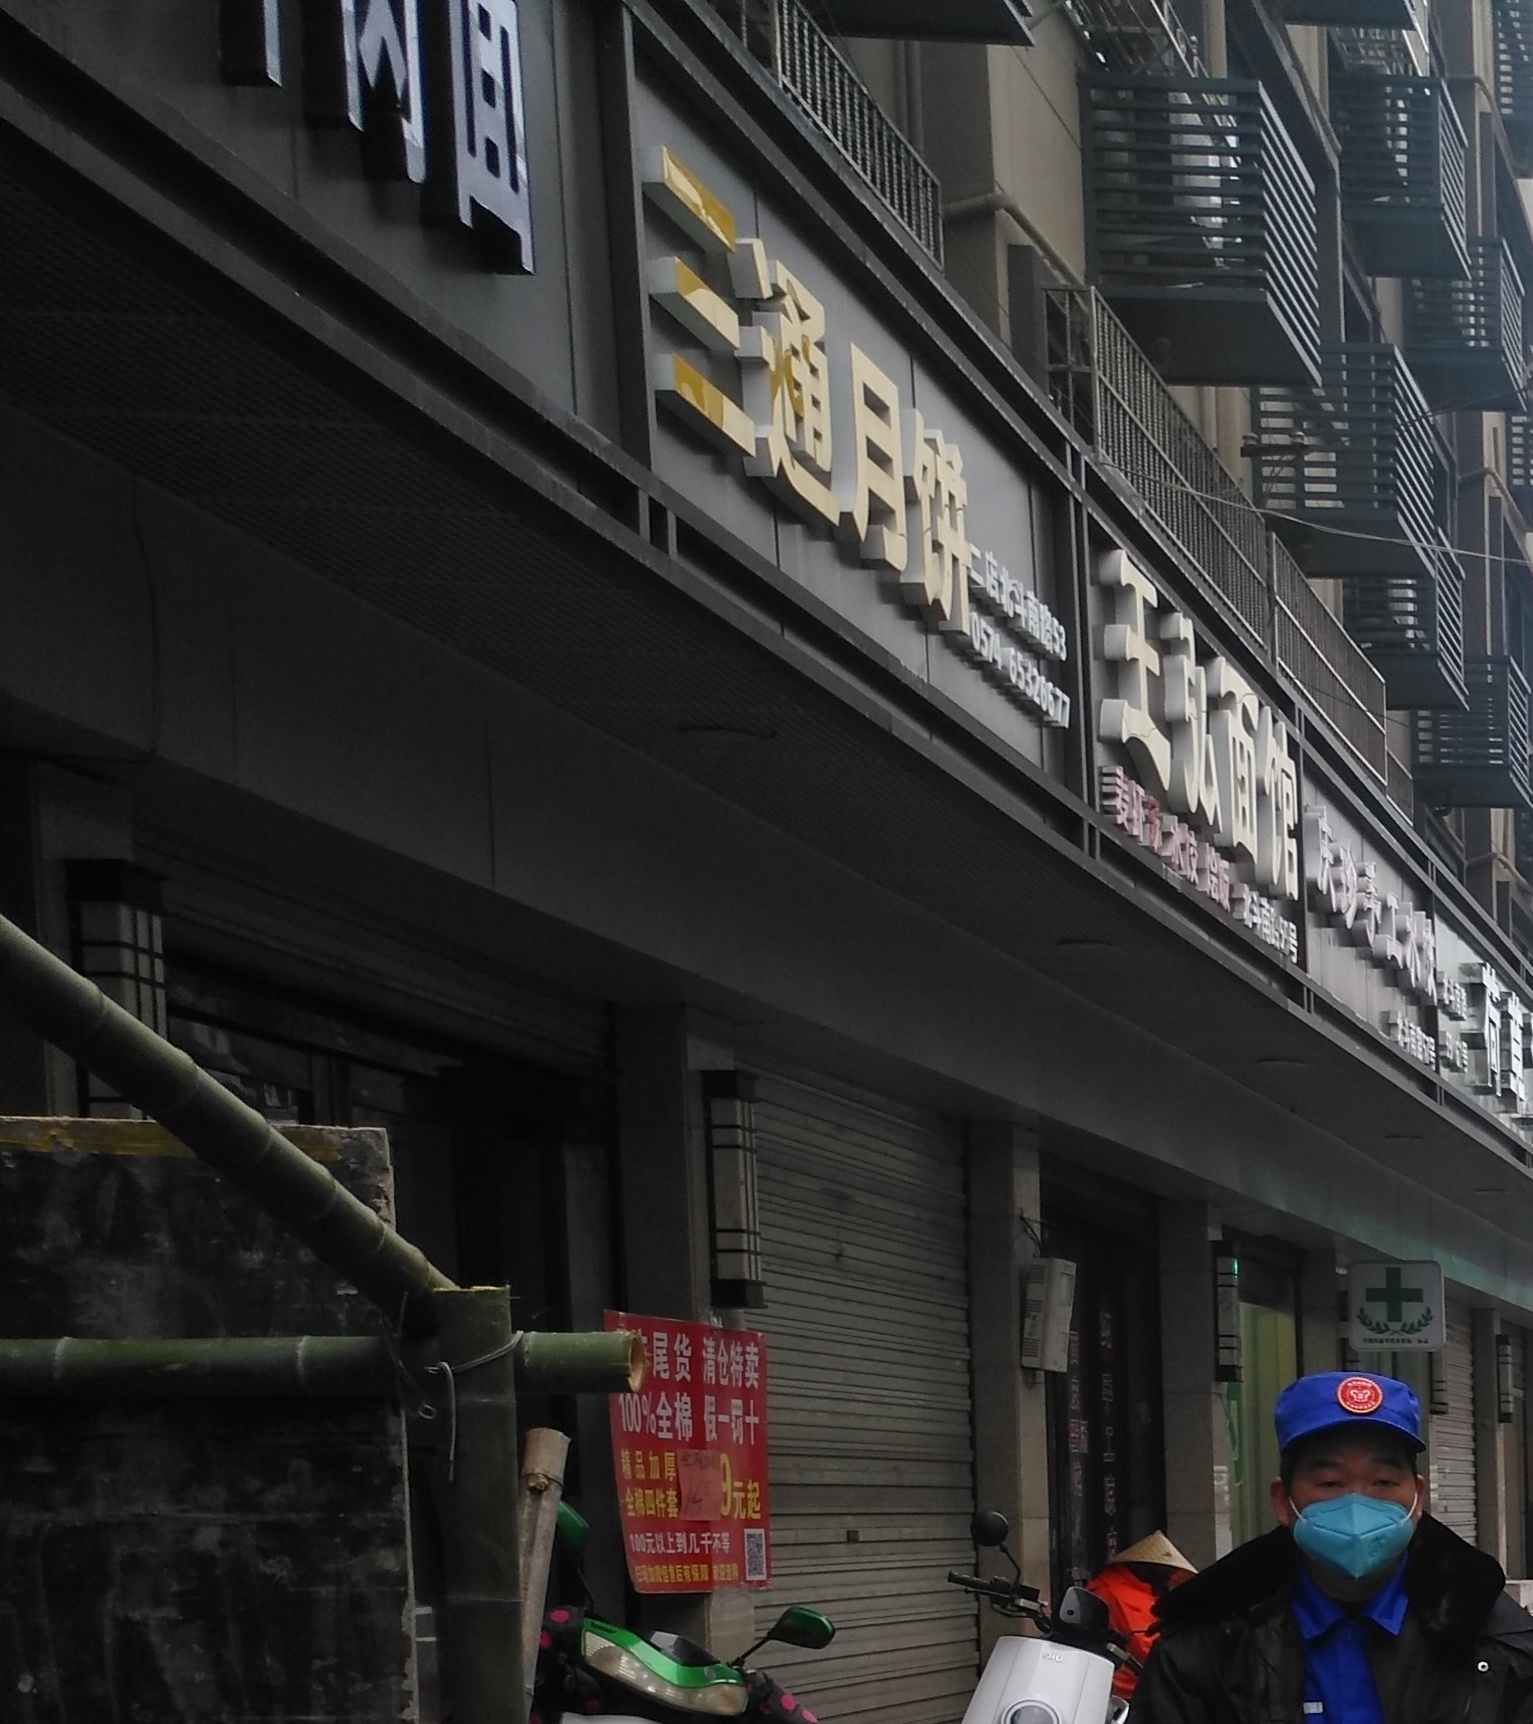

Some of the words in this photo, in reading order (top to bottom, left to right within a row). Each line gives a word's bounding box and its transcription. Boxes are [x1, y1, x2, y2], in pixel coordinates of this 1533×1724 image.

[650, 146, 970, 637] 三通月饼
[969, 610, 1003, 670] 0574
[1008, 646, 1071, 729] 65326677
[703, 1335, 760, 1390] 清仓特卖
[618, 1391, 694, 1442] 100%全棉
[704, 1397, 760, 1446] 假一罚十
[621, 1448, 677, 1482] 精品加厚
[625, 1486, 679, 1519] 全棉四件套
[629, 1531, 731, 1555] 100元以上到几千不等
